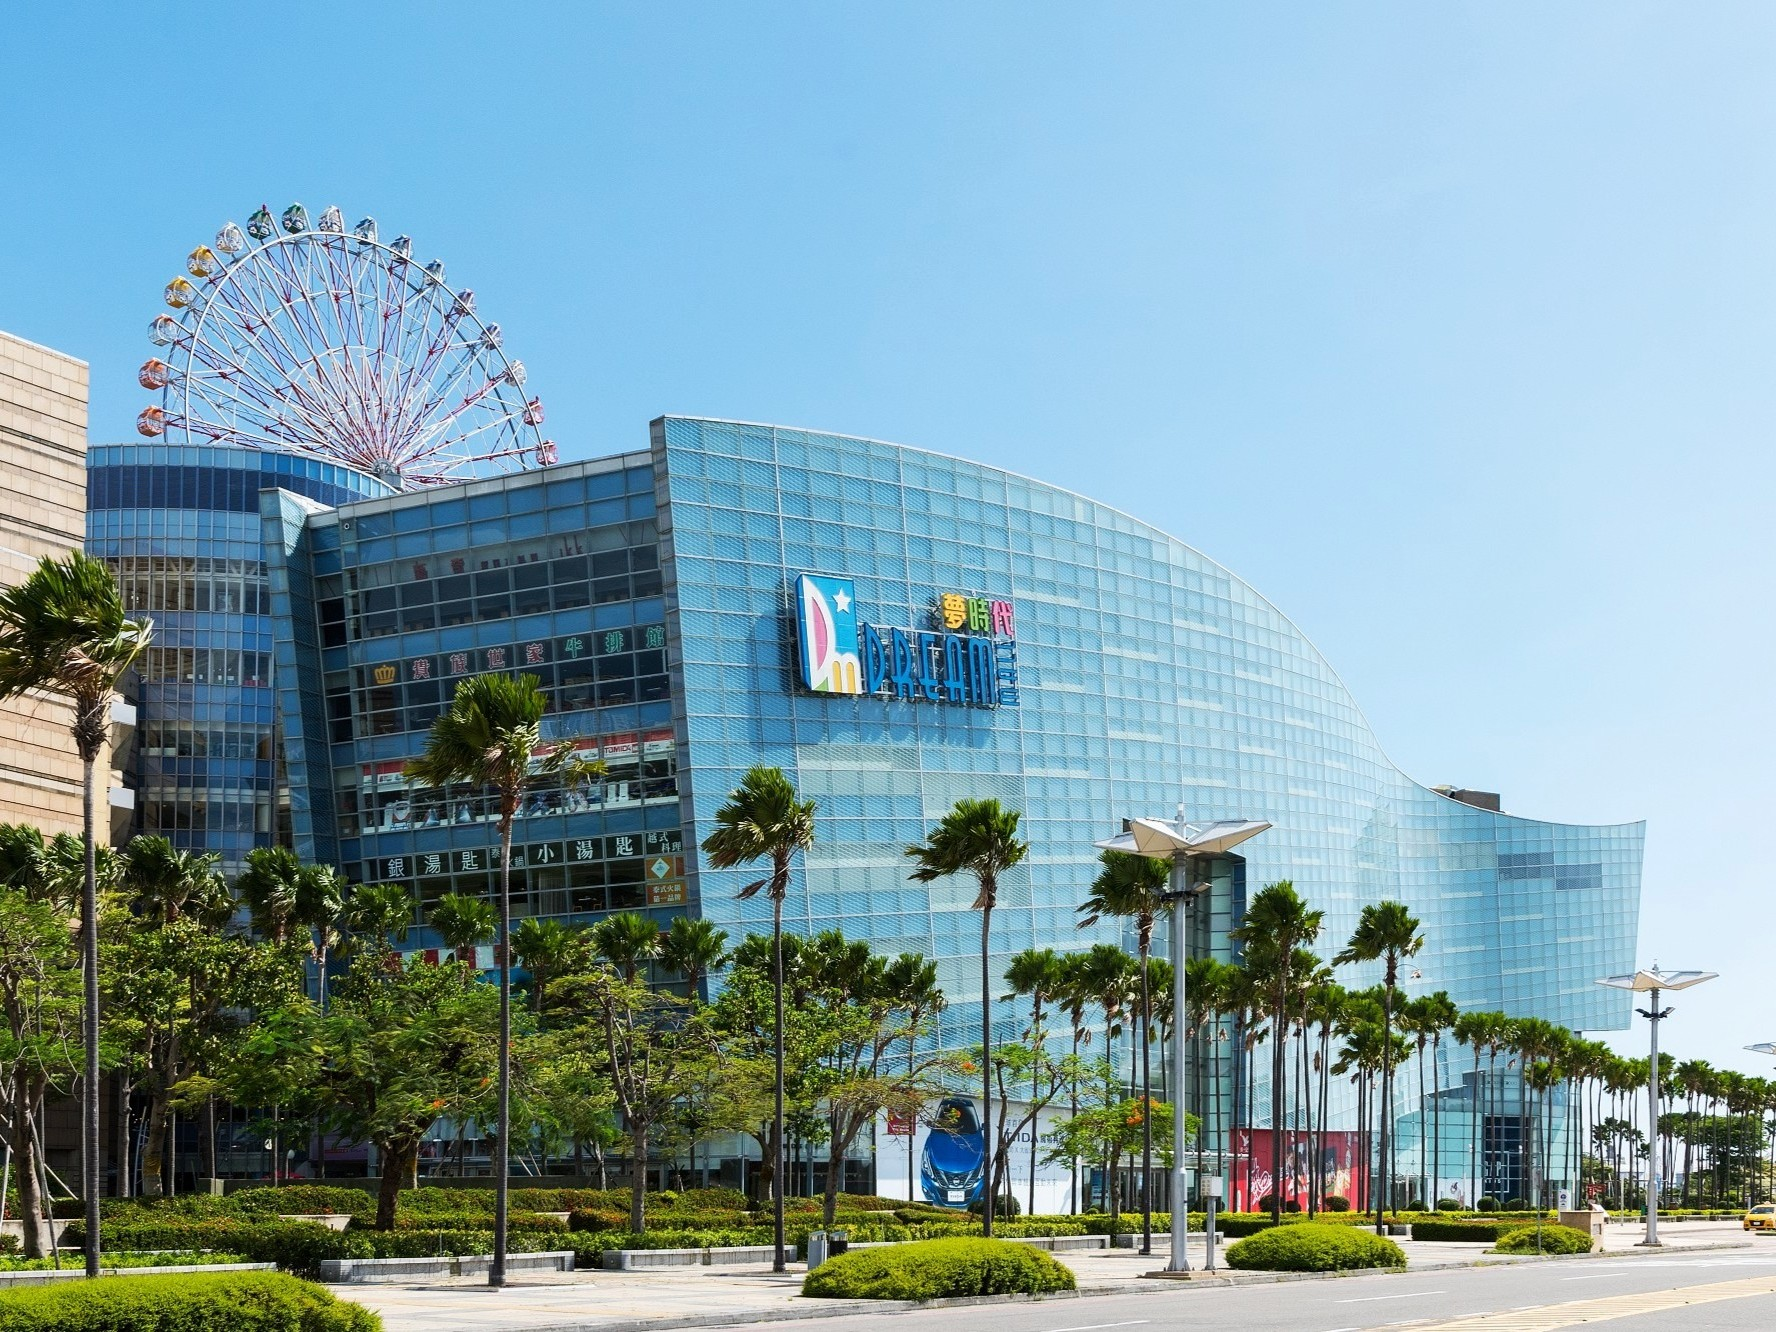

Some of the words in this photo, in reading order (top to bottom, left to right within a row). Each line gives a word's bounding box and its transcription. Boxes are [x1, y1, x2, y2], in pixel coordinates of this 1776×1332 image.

[941, 593, 1015, 636] 夢時代
[863, 622, 996, 705] DREAM
[387, 850, 479, 878] 銀湯匙
[537, 836, 634, 864] 小湯匙
